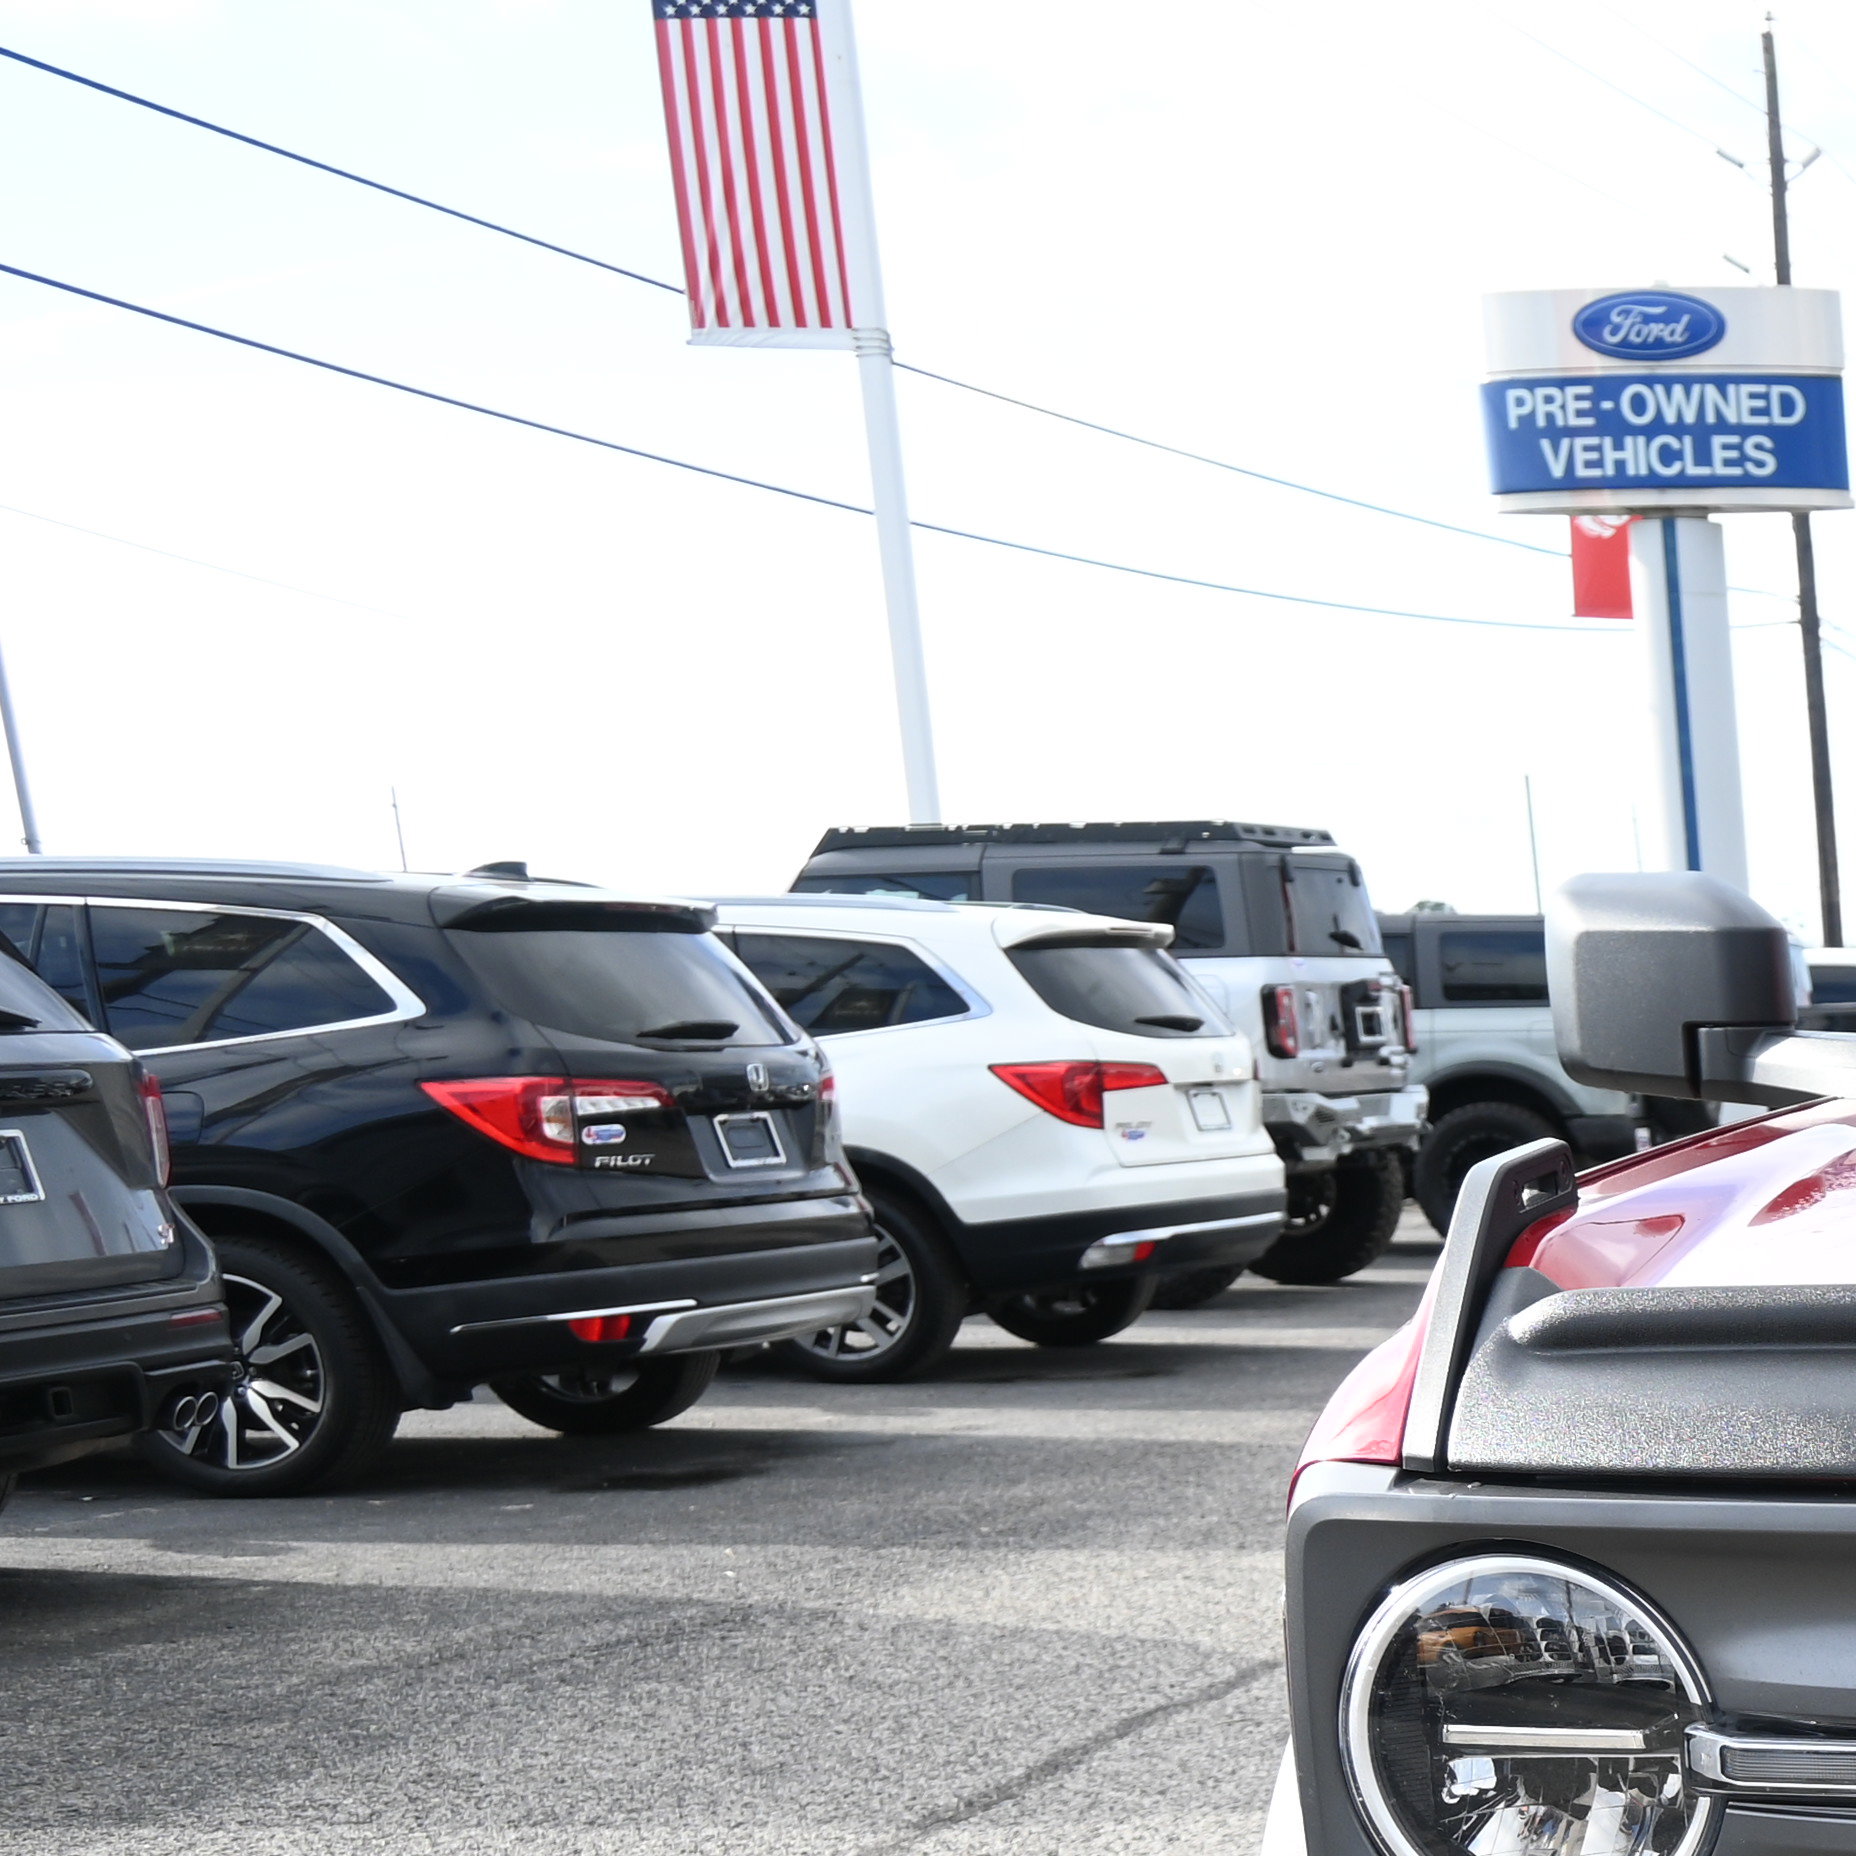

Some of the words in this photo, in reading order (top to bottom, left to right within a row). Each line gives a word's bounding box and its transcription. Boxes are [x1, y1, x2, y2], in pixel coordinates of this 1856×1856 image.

[1602, 303, 1692, 346] Ford
[1506, 383, 1807, 429] PRE-OWNED
[1540, 434, 1778, 479] VEHICLES
[594, 1153, 656, 1168] PILOT
